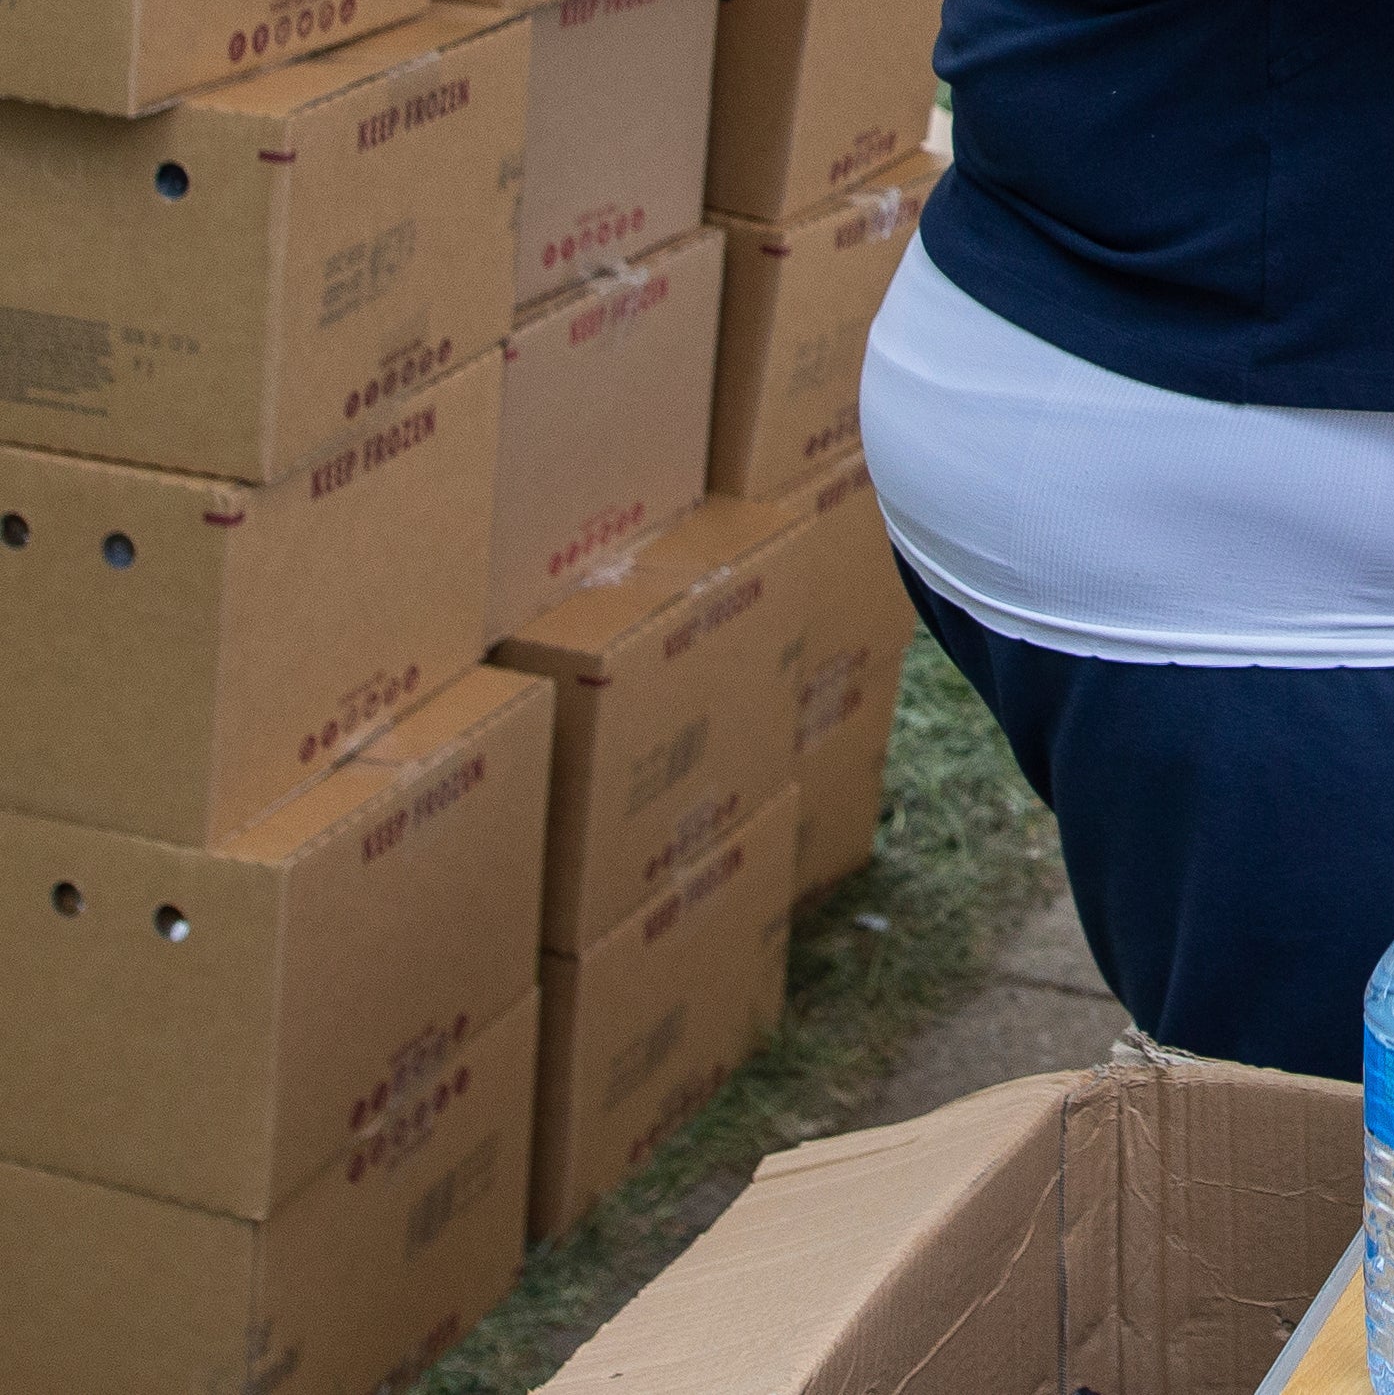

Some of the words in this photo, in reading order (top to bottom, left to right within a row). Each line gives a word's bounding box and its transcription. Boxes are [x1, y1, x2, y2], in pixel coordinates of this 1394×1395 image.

[357, 108, 398, 154] KEEP
[405, 78, 469, 130] FROZEN
[571, 306, 606, 346] KEEP
[311, 450, 356, 499] KEEP
[364, 407, 436, 471] FROZEN
[363, 810, 408, 864] KEEP
[414, 755, 485, 826] FROZEN
